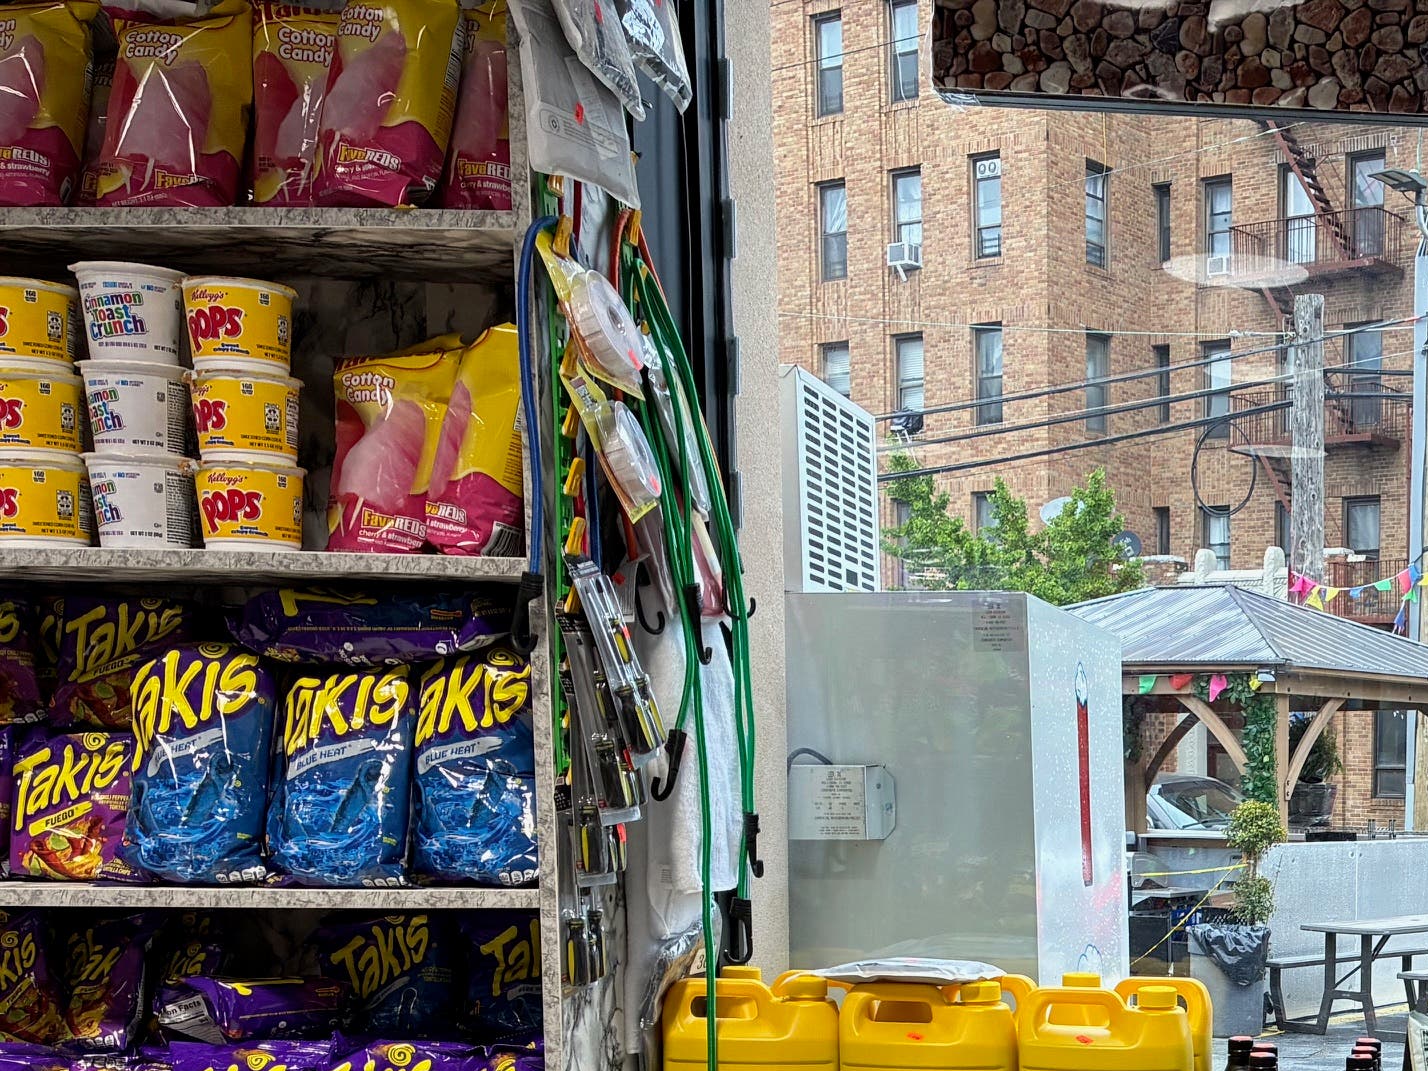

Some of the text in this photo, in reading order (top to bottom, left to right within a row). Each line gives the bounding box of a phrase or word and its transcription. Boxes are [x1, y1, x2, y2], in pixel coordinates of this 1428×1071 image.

[341, 5, 384, 21] Cotton
[125, 31, 183, 47] Cotton
[278, 27, 335, 48] Cotton
[338, 23, 380, 42] Candy
[125, 44, 179, 66] Candy
[279, 43, 333, 67] Candy
[84, 291, 142, 311] Cinnamon
[191, 290, 226, 301] Kellogg's
[91, 304, 131, 324] Toast
[90, 315, 147, 342] Crunch
[188, 305, 243, 351] POPS
[342, 372, 395, 389] Cotton
[208, 473, 245, 486] Kellogg's
[201, 489, 261, 533] POPS
[13, 738, 127, 830] Takis
[45, 810, 75, 827] FUEGO
